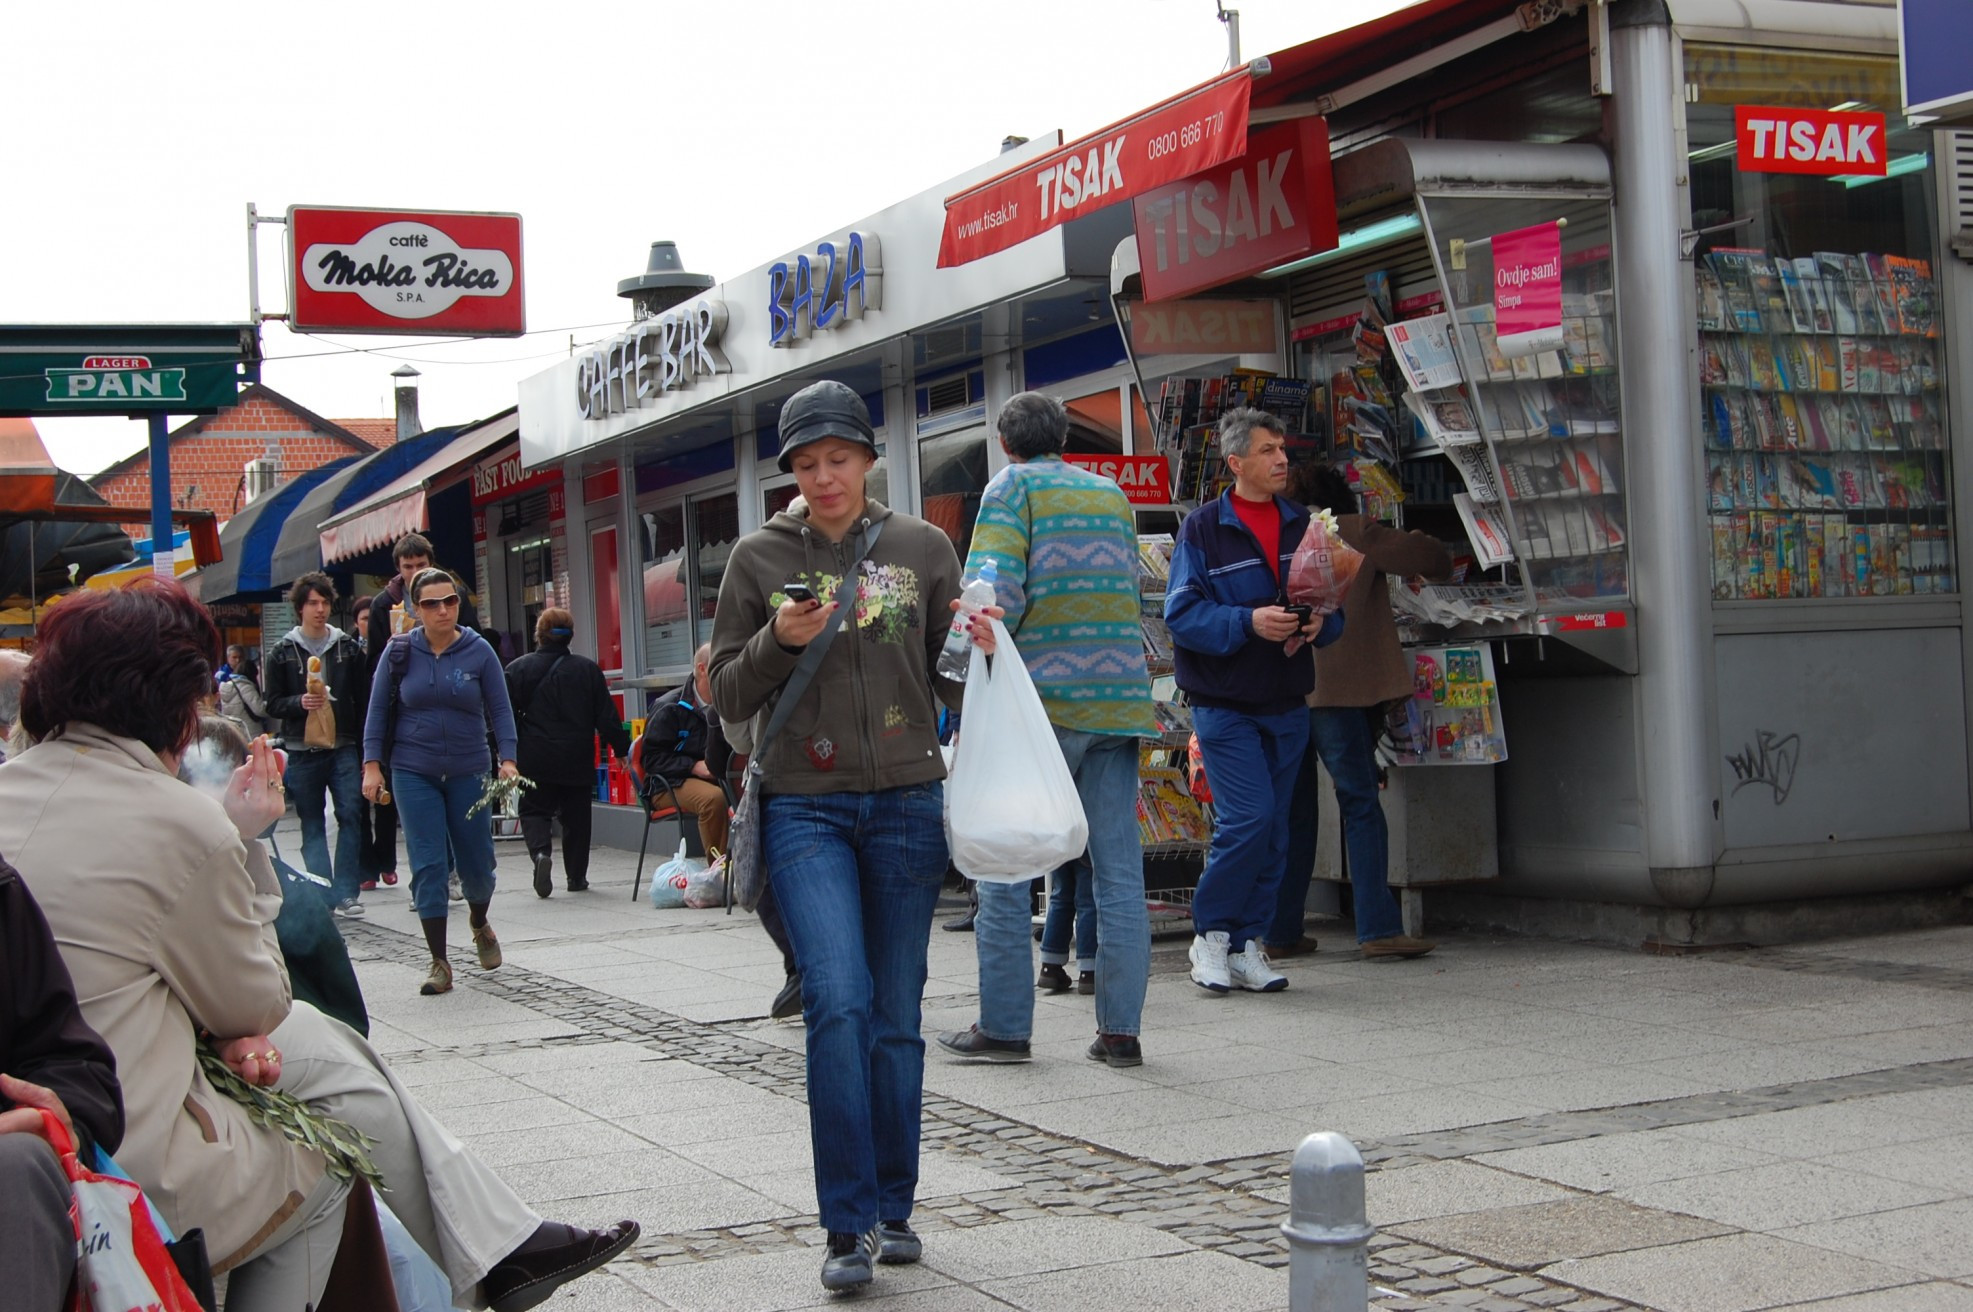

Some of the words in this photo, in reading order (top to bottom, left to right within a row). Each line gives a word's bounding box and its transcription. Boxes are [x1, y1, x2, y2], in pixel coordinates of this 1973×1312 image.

[1148, 130, 1177, 160] 0800
[1180, 121, 1201, 149] 666
[1204, 111, 1224, 139] 770
[1747, 119, 1878, 164] TISAK
[1036, 134, 1127, 222] TISAK
[957, 200, 1019, 240] www.tisak.hr
[1144, 148, 1296, 273] TISAK
[389, 234, 429, 248] caffè
[318, 250, 417, 287] Moka
[422, 252, 500, 289] Rica
[1497, 263, 1530, 288] Ovdje
[1531, 256, 1558, 280] sam!
[767, 231, 867, 348] BAZA
[1498, 293, 1522, 310] Simpa
[92, 359, 140, 368] LAGER
[575, 325, 650, 420] CAFFE
[660, 300, 716, 392] BAR
[68, 372, 162, 397] PAN
[1267, 380, 1308, 397] dinamo
[473, 464, 499, 497] FAST
